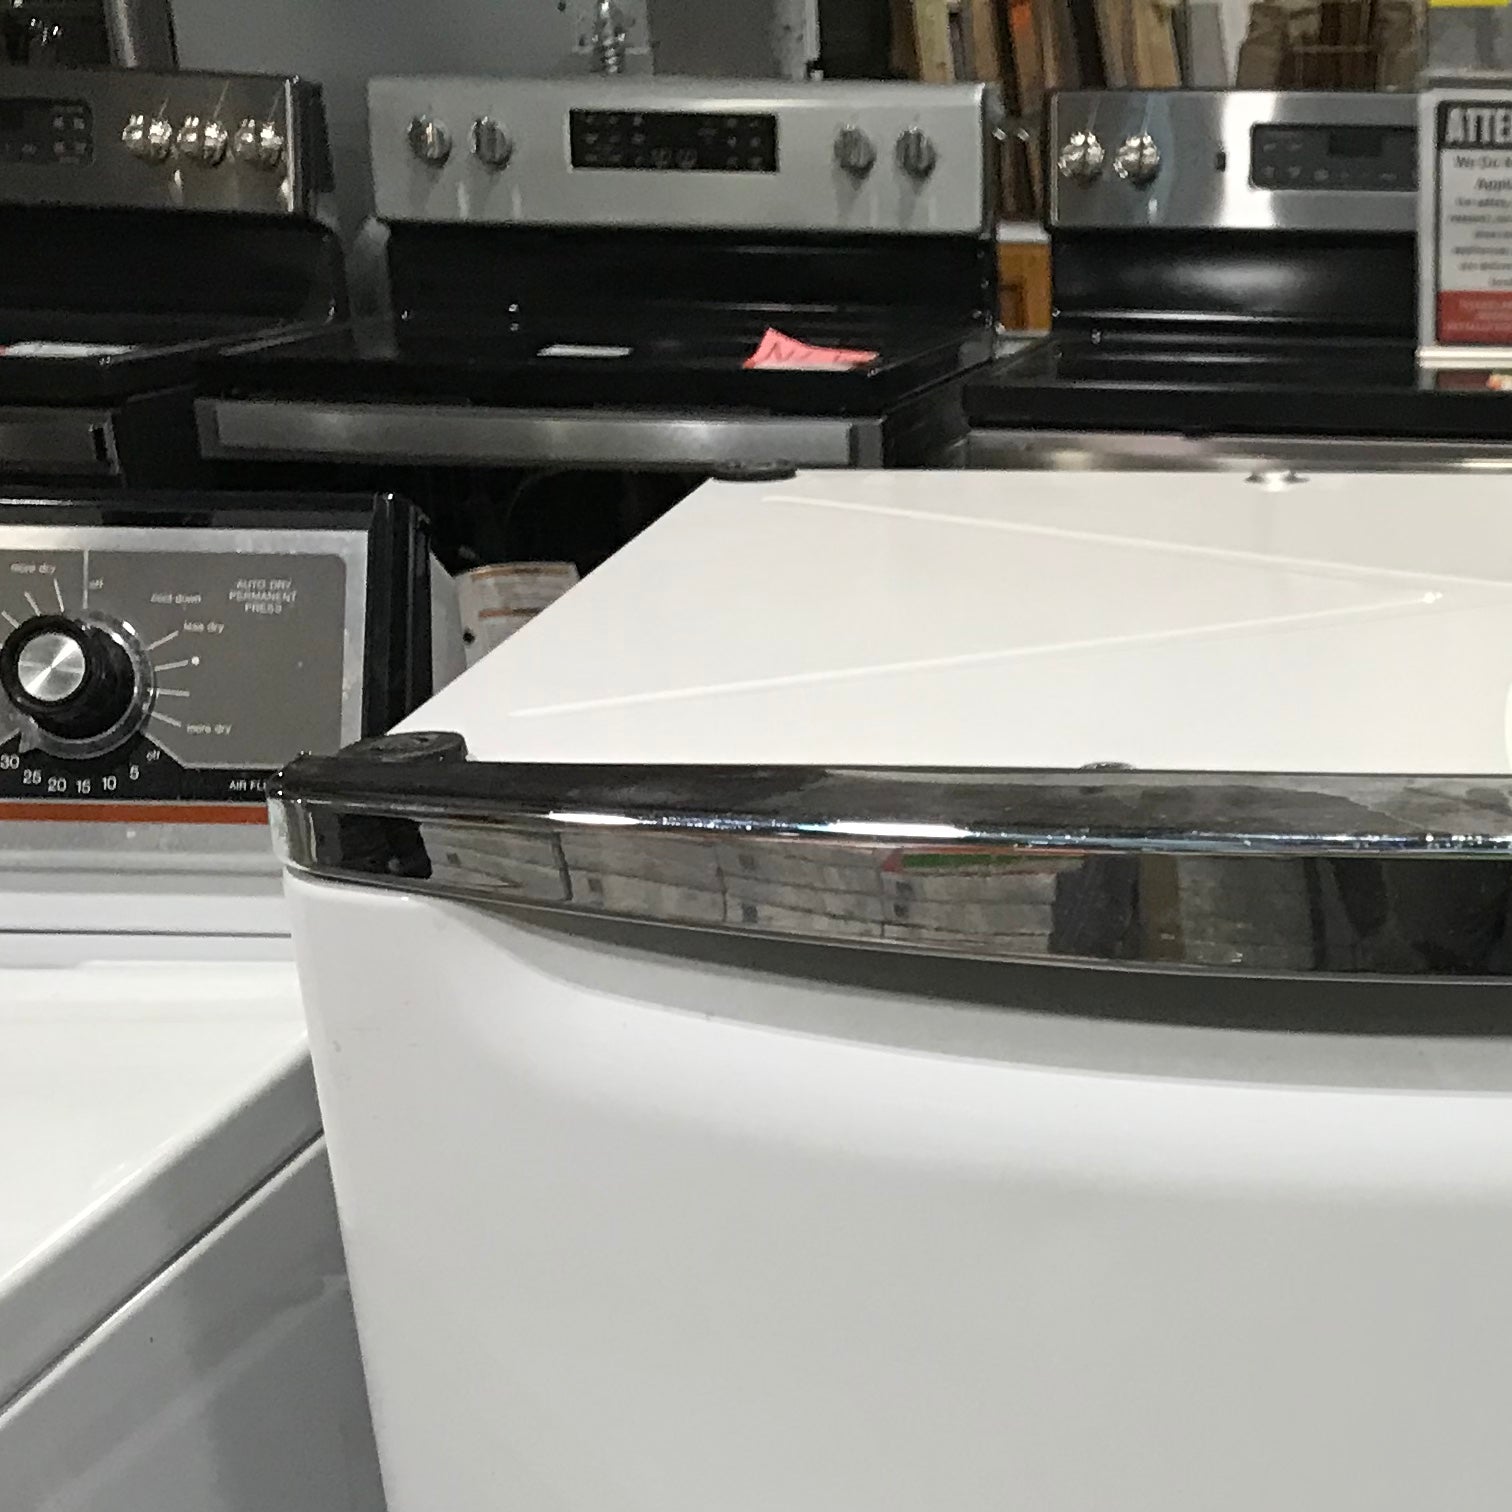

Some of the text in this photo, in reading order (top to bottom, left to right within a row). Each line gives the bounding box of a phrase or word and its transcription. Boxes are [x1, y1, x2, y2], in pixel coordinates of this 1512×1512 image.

[236, 577, 292, 590] AUTO DRY
[229, 590, 297, 602] PERMANENT
[245, 602, 282, 614] PRESS
[0, 754, 20, 770] 30
[47, 777, 67, 792] 20
[102, 775, 117, 791] 10
[129, 765, 140, 781] 5
[229, 779, 247, 791] AIR
